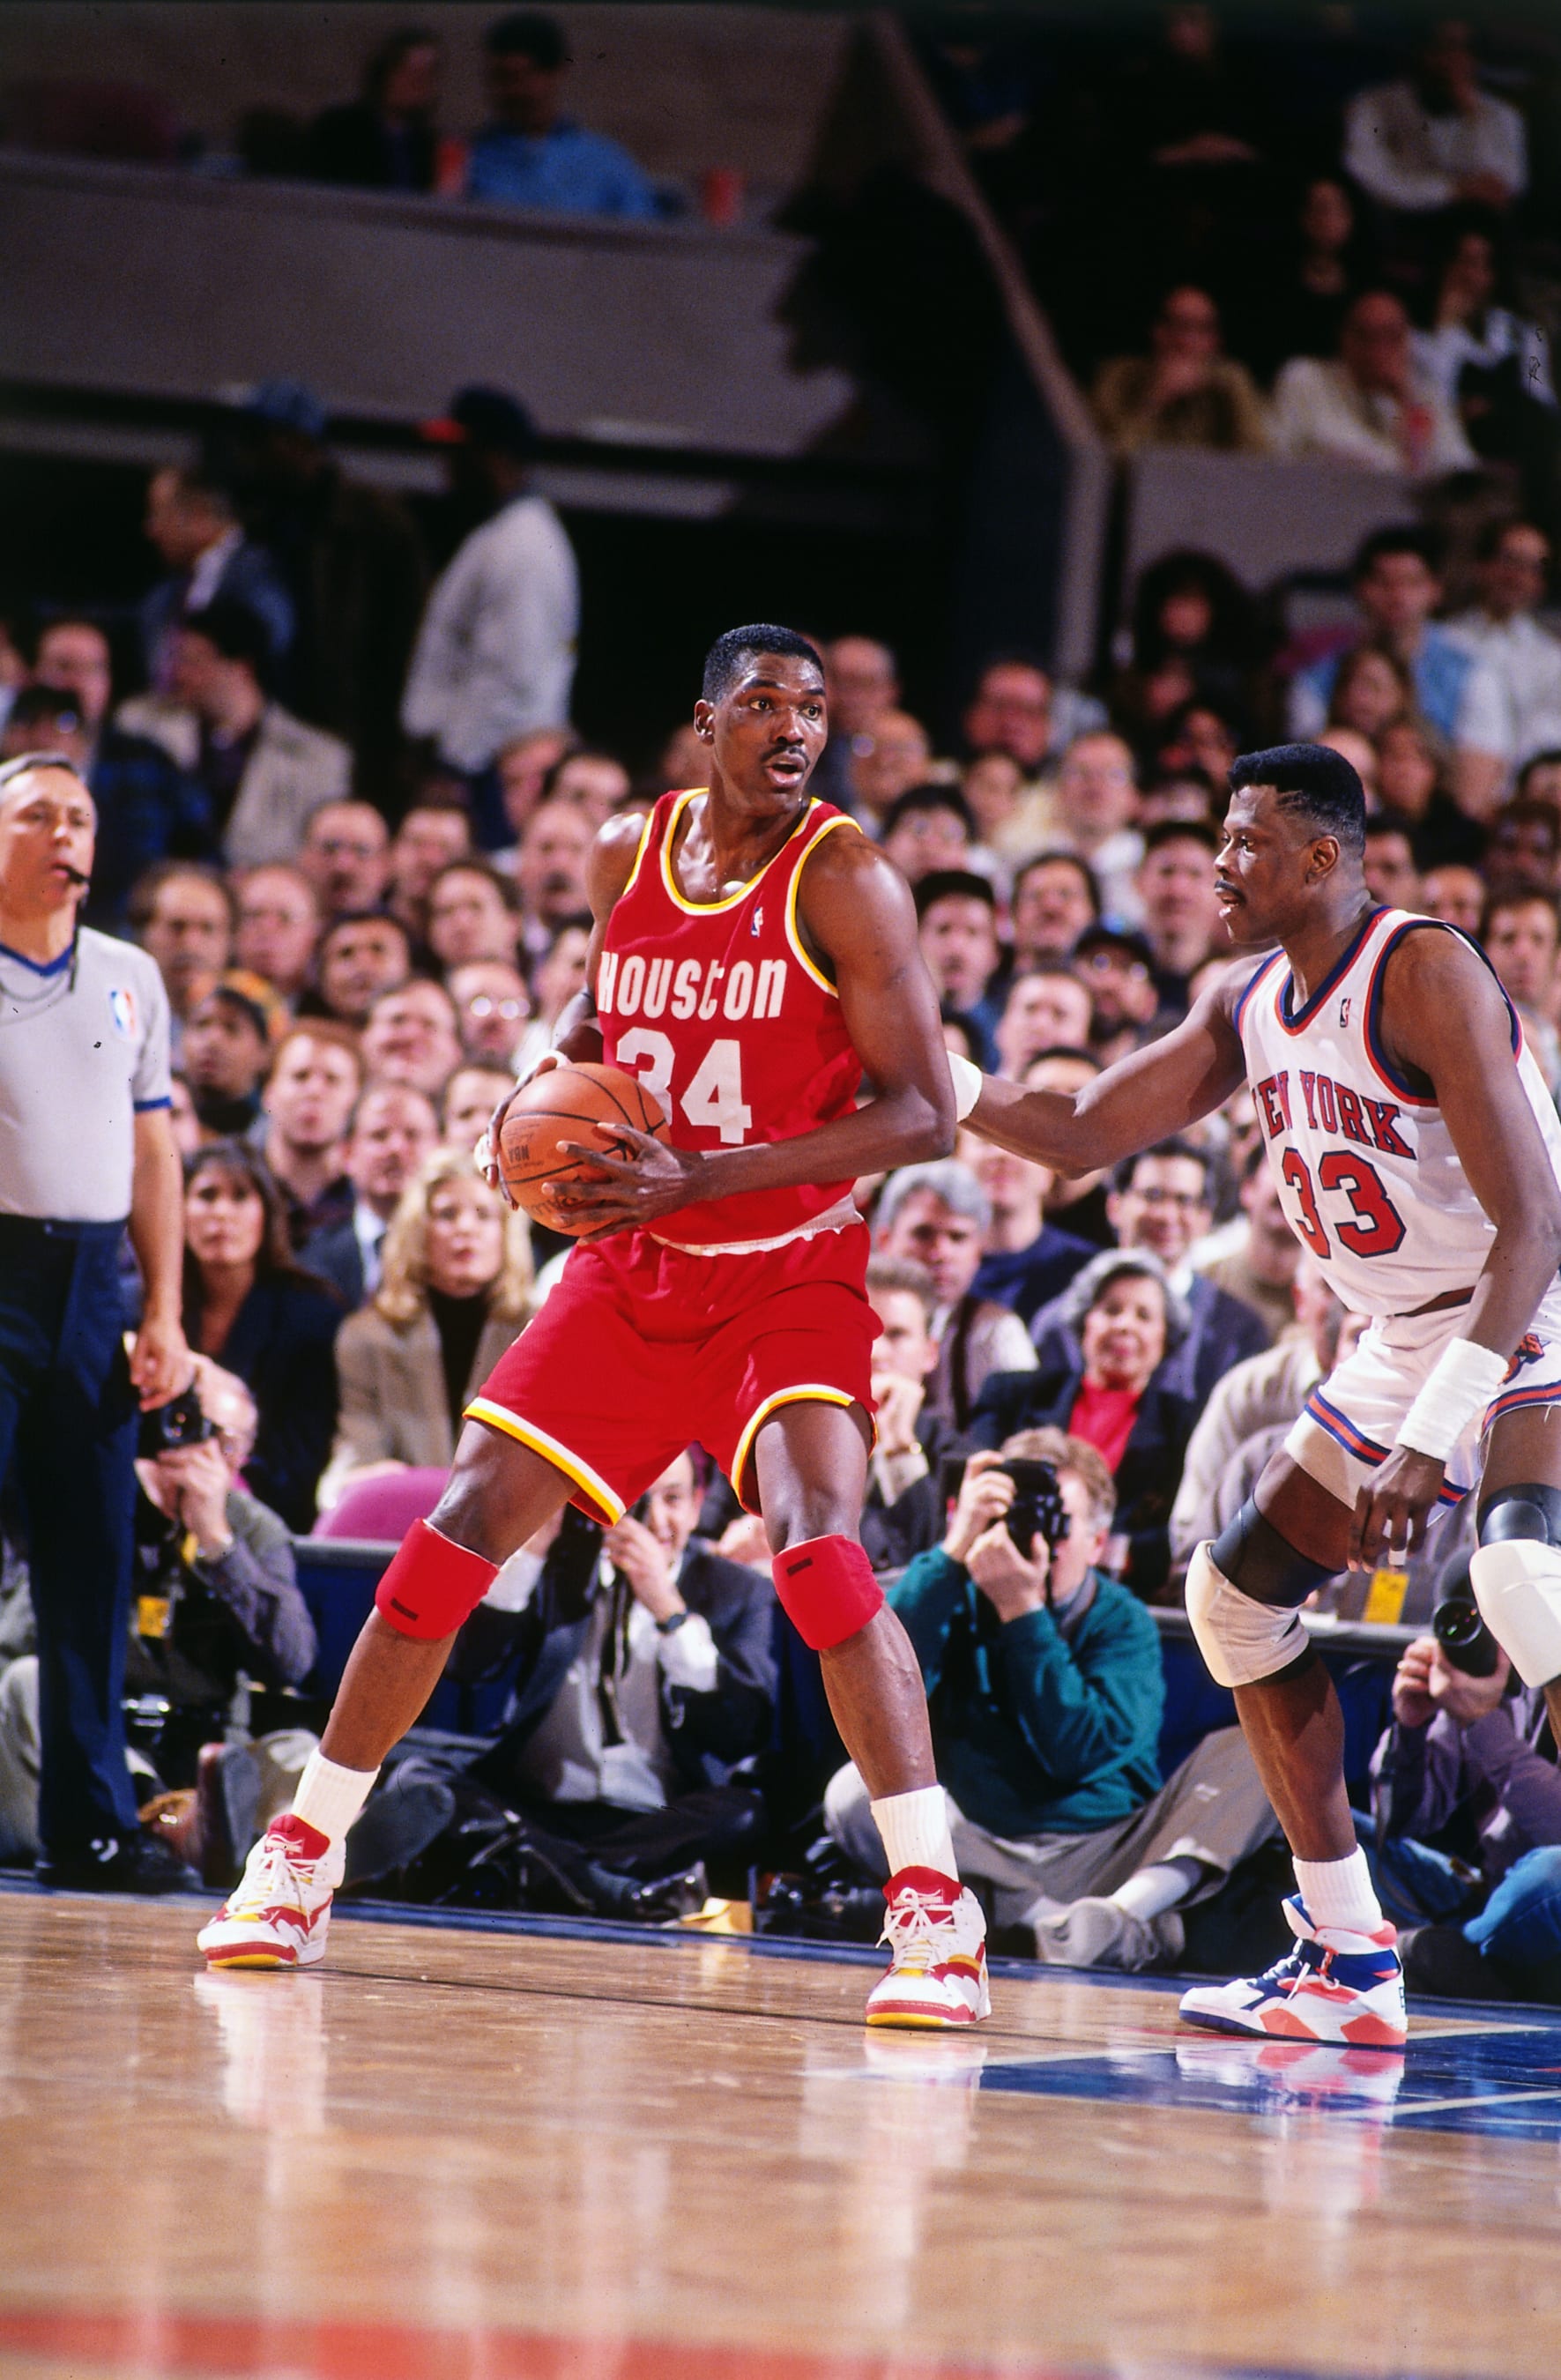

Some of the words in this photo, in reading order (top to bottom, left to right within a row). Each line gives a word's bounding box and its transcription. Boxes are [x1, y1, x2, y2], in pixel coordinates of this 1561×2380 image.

[598, 951, 788, 1021] HOUSTON
[616, 1026, 753, 1145] 34
[1253, 1069, 1293, 1140] EW
[1299, 1069, 1417, 1161] YORK
[508, 1144, 530, 1164] NBA
[1282, 1147, 1407, 1260] 33
